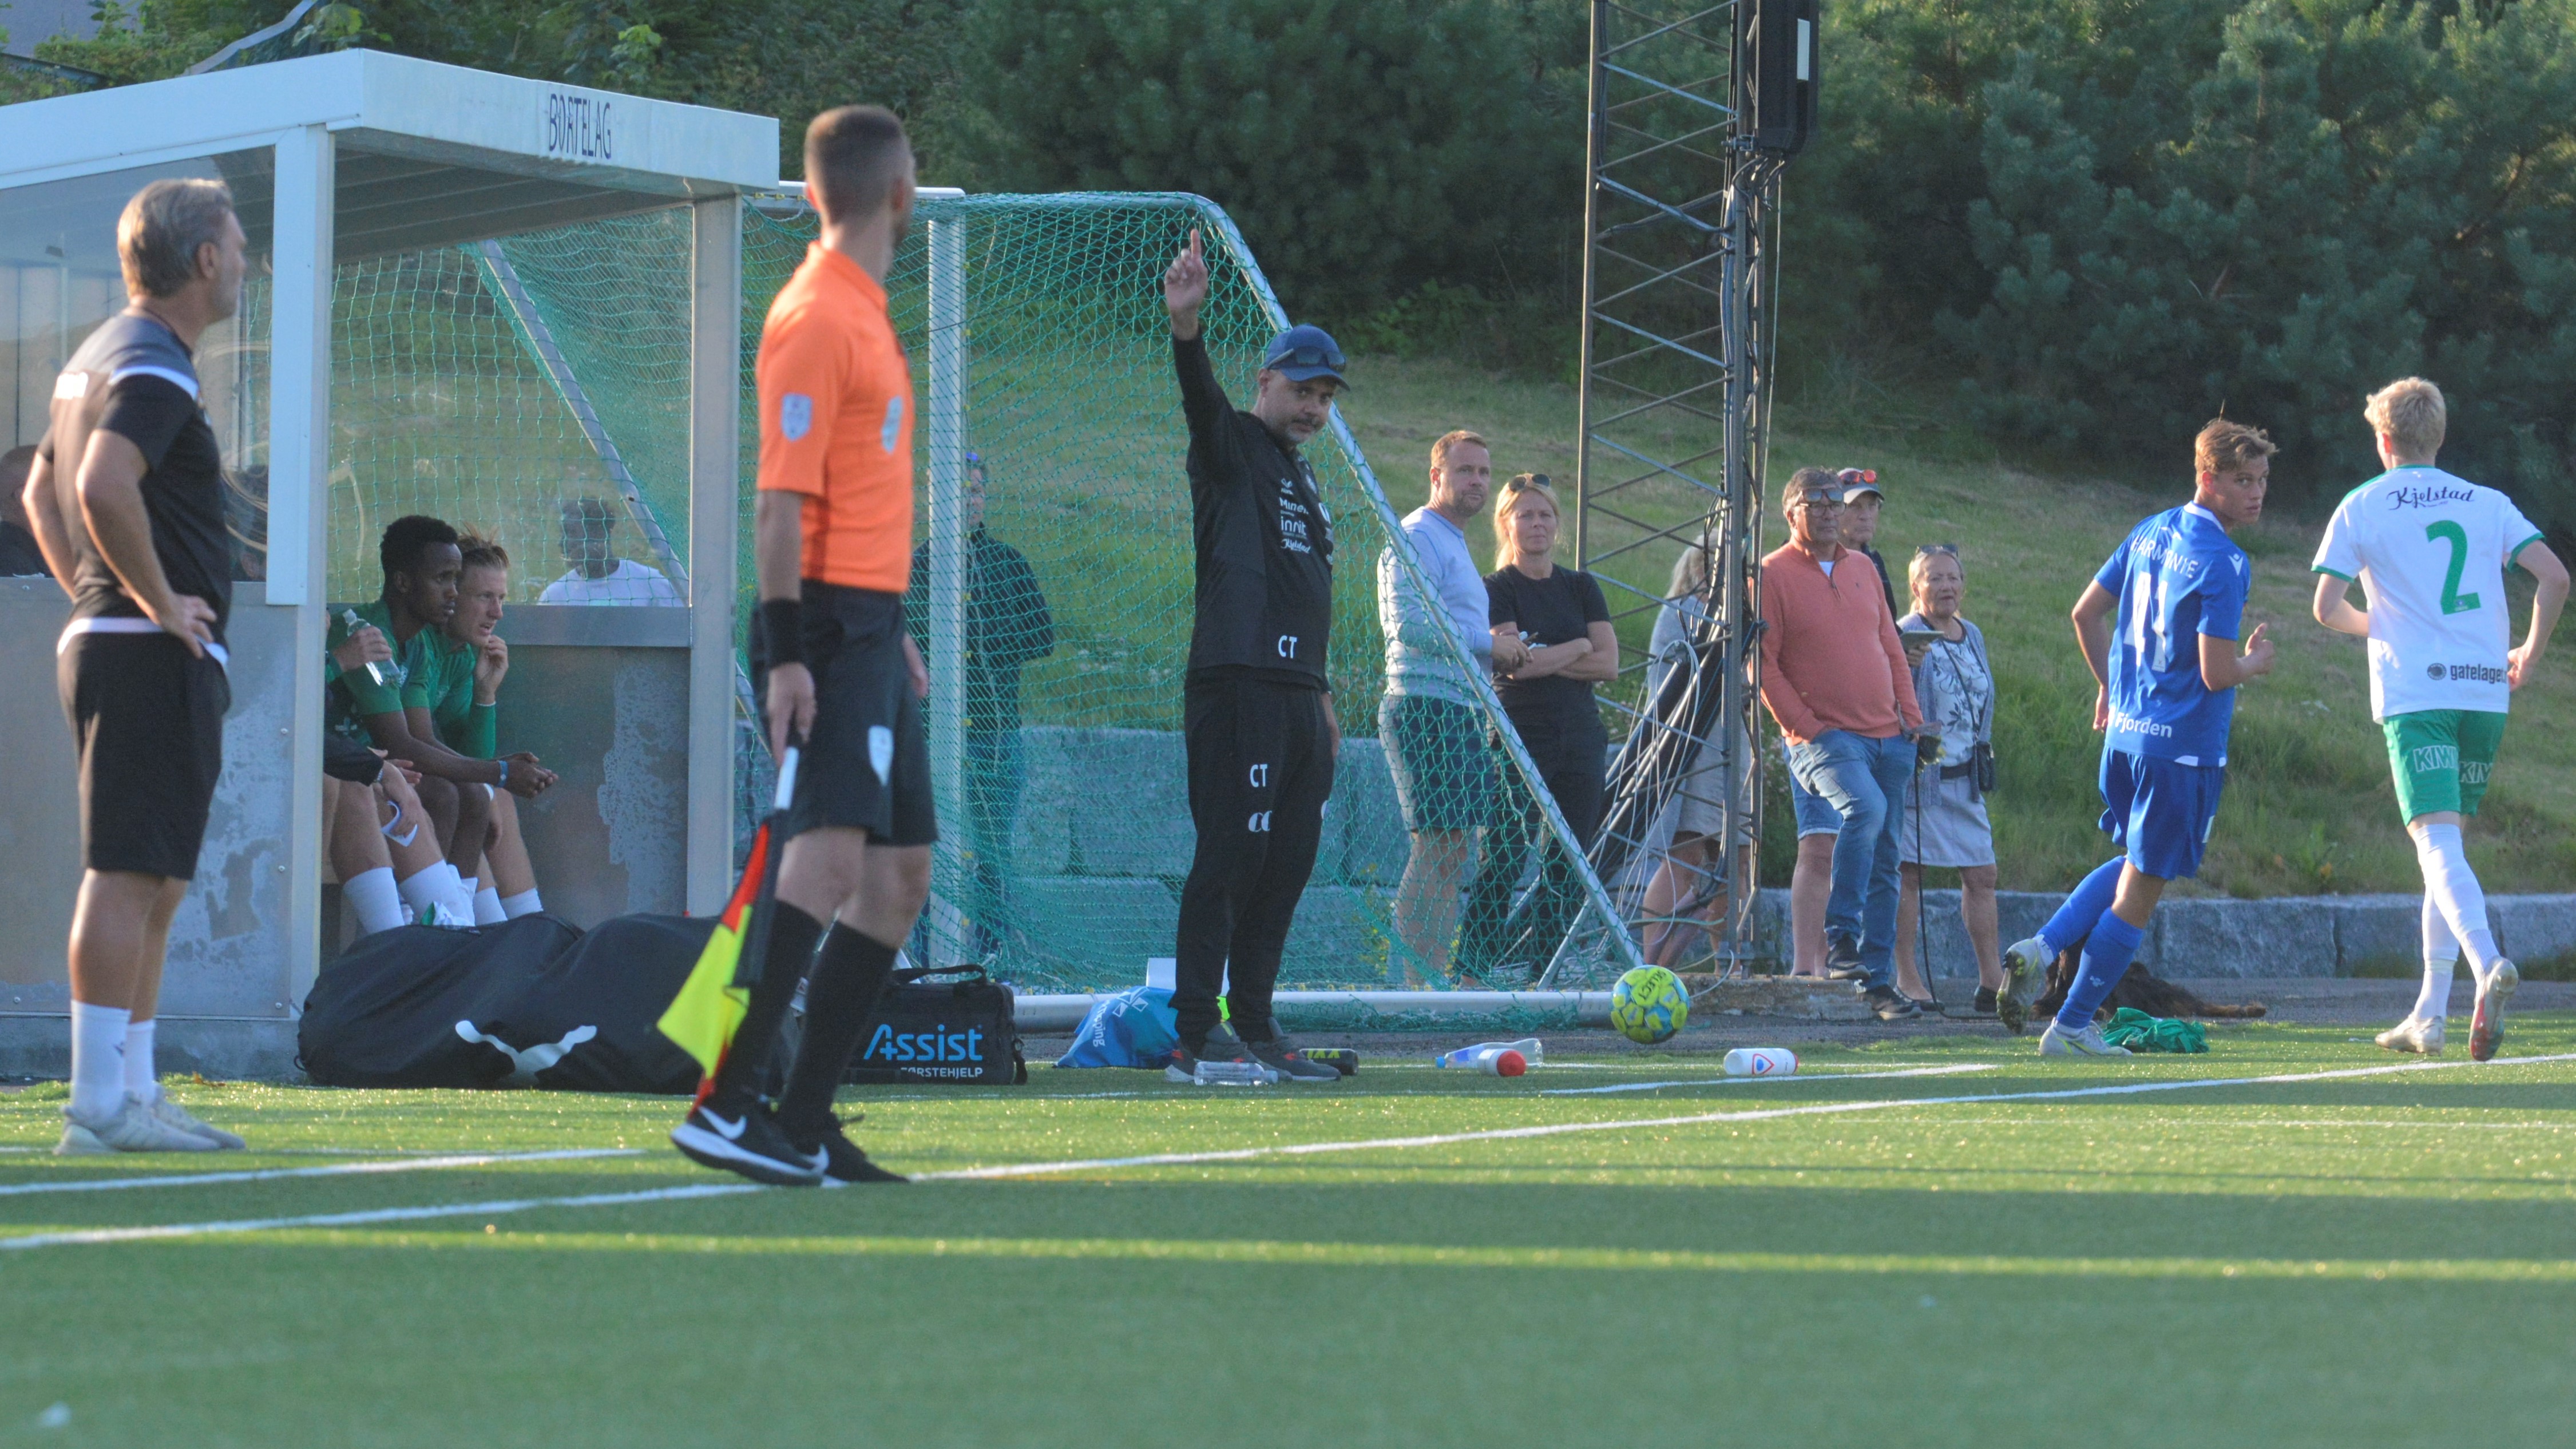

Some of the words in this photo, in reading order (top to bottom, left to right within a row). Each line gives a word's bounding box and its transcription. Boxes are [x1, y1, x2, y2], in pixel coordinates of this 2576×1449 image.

[549, 93, 611, 159] BORTELAG
[2387, 486, 2474, 510] Kjelstad
[1281, 516, 1306, 536] innit
[2426, 520, 2480, 615] 2
[1278, 635, 1297, 659] CT
[2115, 711, 2172, 738] Fjorden
[1250, 764, 1267, 787] CT
[863, 1024, 982, 1061] Assist
